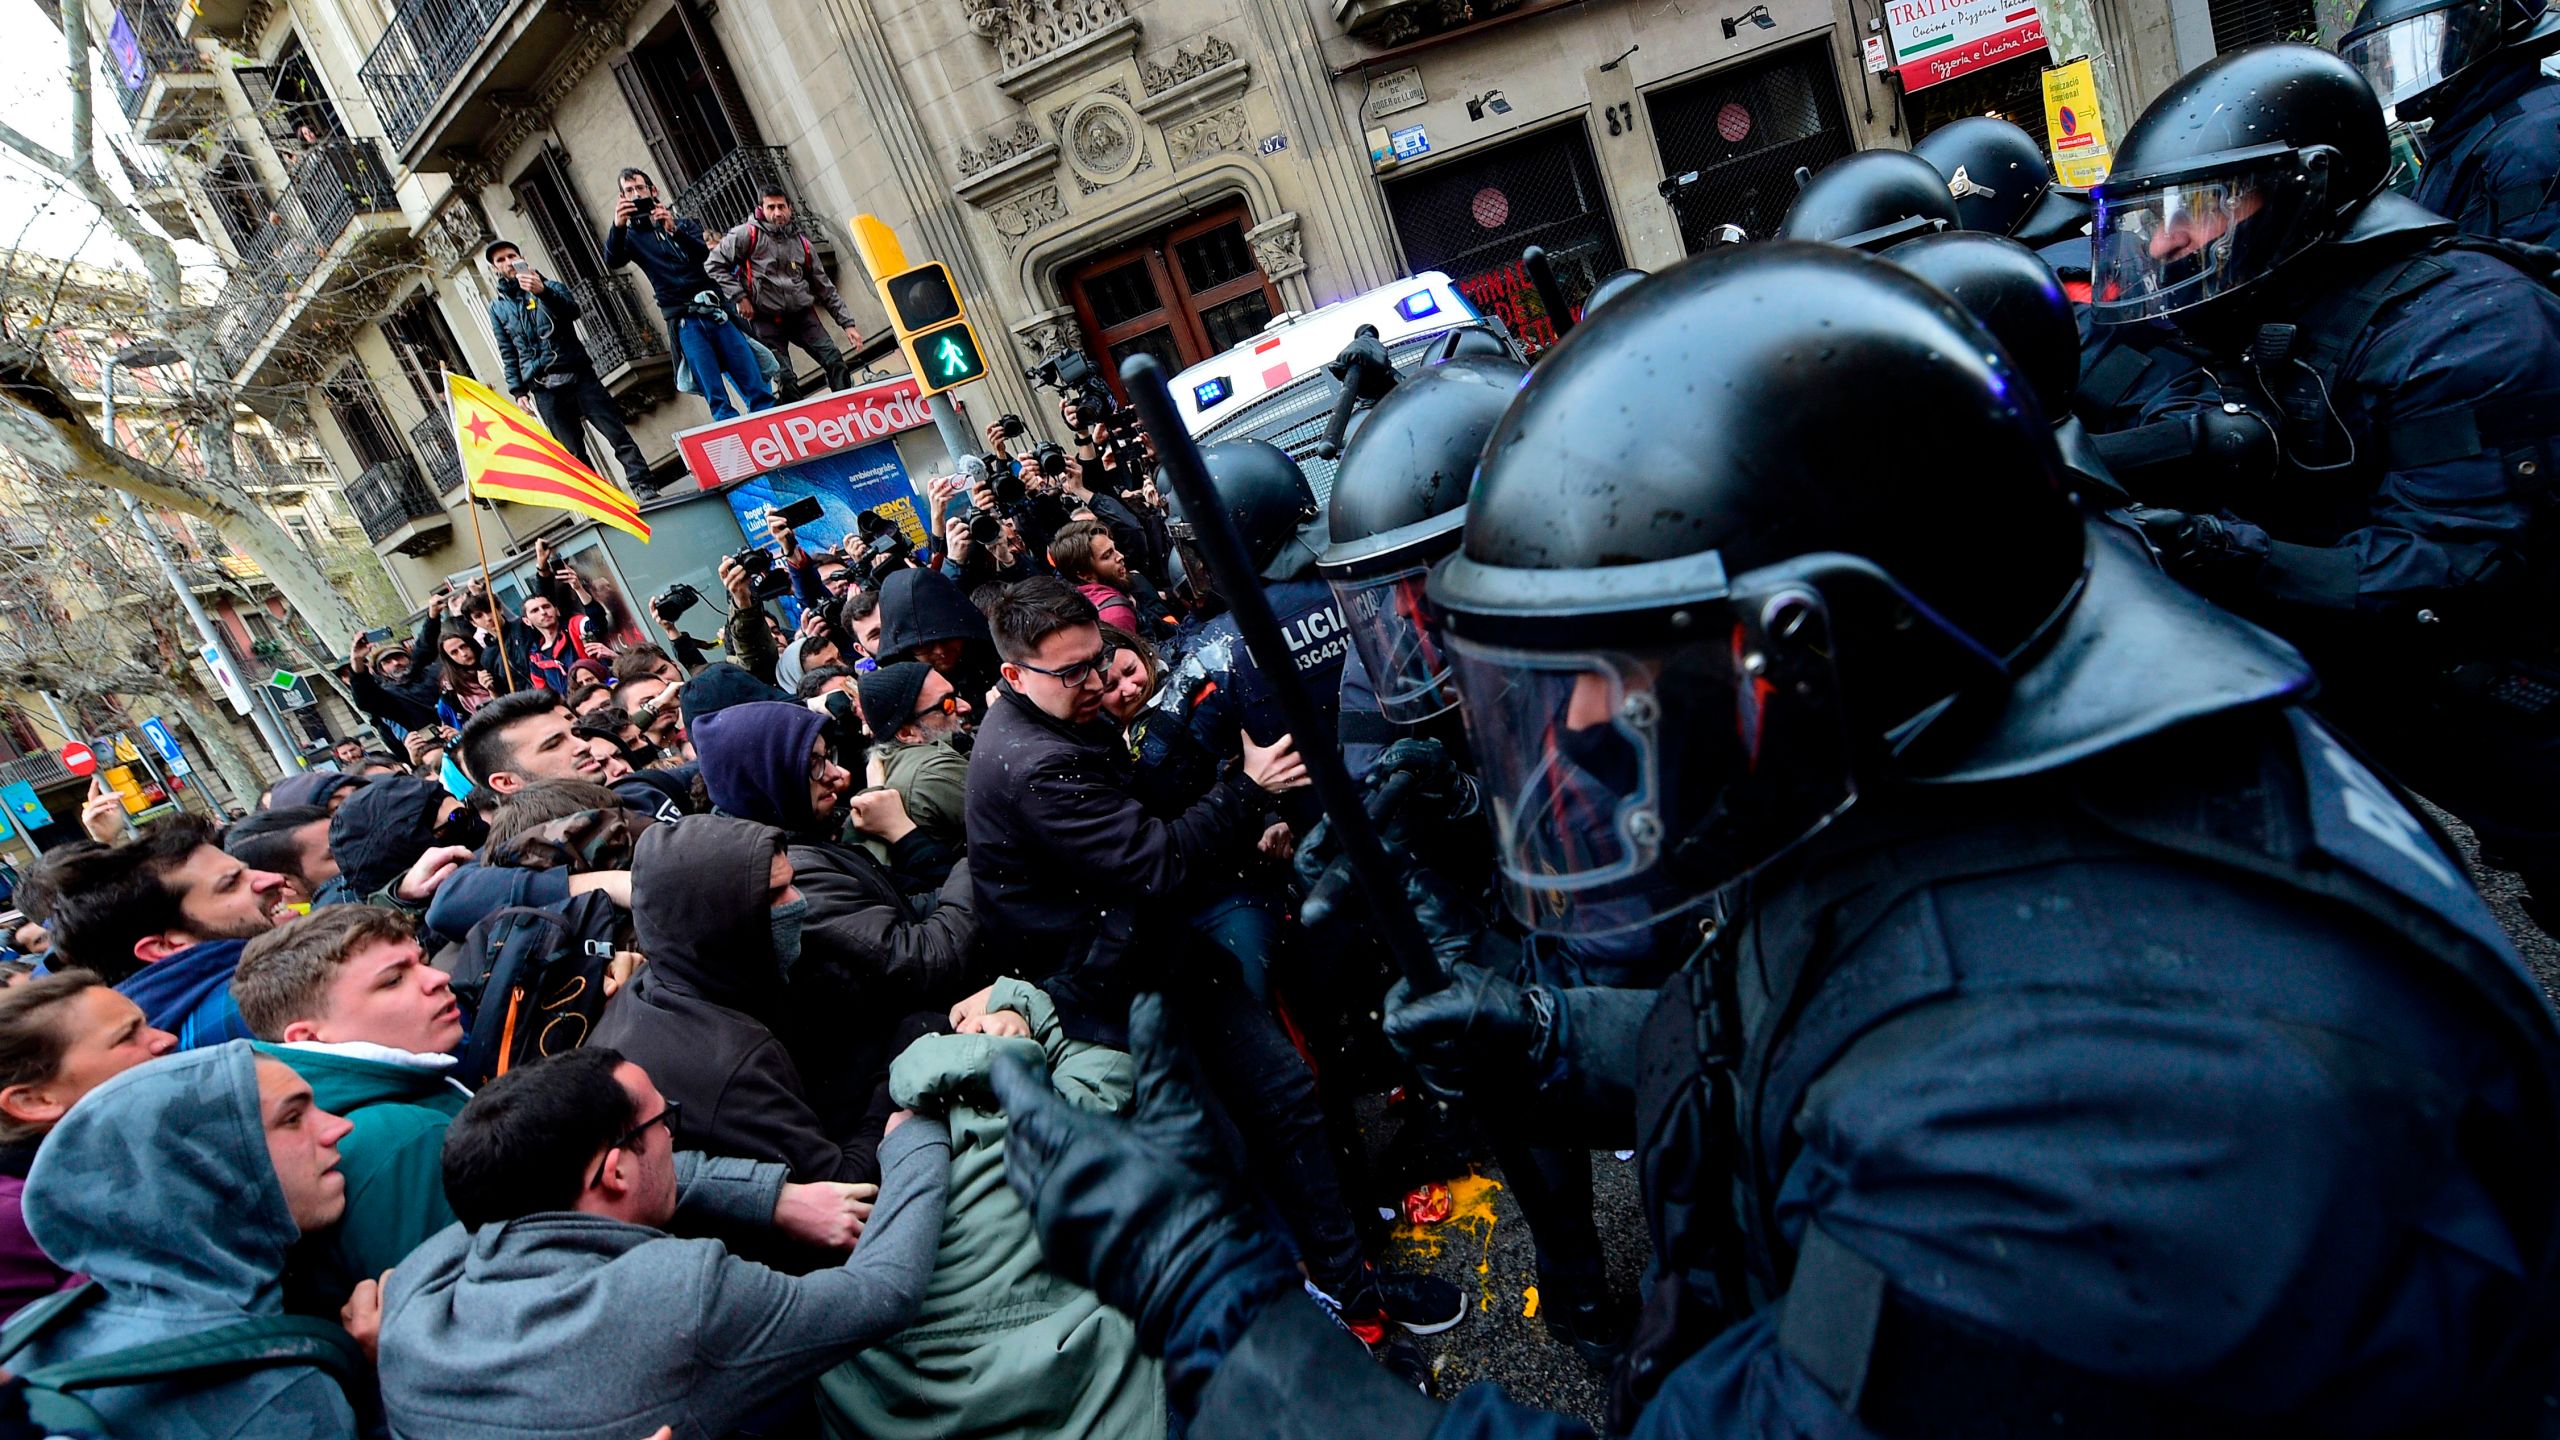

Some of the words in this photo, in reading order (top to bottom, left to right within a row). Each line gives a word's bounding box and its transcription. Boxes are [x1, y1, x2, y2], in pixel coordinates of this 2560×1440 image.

[1911, 21, 1947, 38] Cucina
[1957, 6, 1997, 25] Pizzeria
[1930, 52, 1971, 79] Pizzeria
[1973, 52, 1981, 60] e
[1982, 36, 2020, 57] Cucina
[1378, 75, 1406, 89] CARRER
[1390, 86, 1400, 95] DE
[1371, 97, 1393, 111] ROGER
[1605, 101, 1633, 137] 87
[1263, 135, 1282, 153] 87
[751, 424, 793, 468] el
[784, 389, 957, 458] Periódic
[743, 506, 764, 521] Roger
[867, 496, 911, 517] GENCY
[146, 725, 170, 759] P
